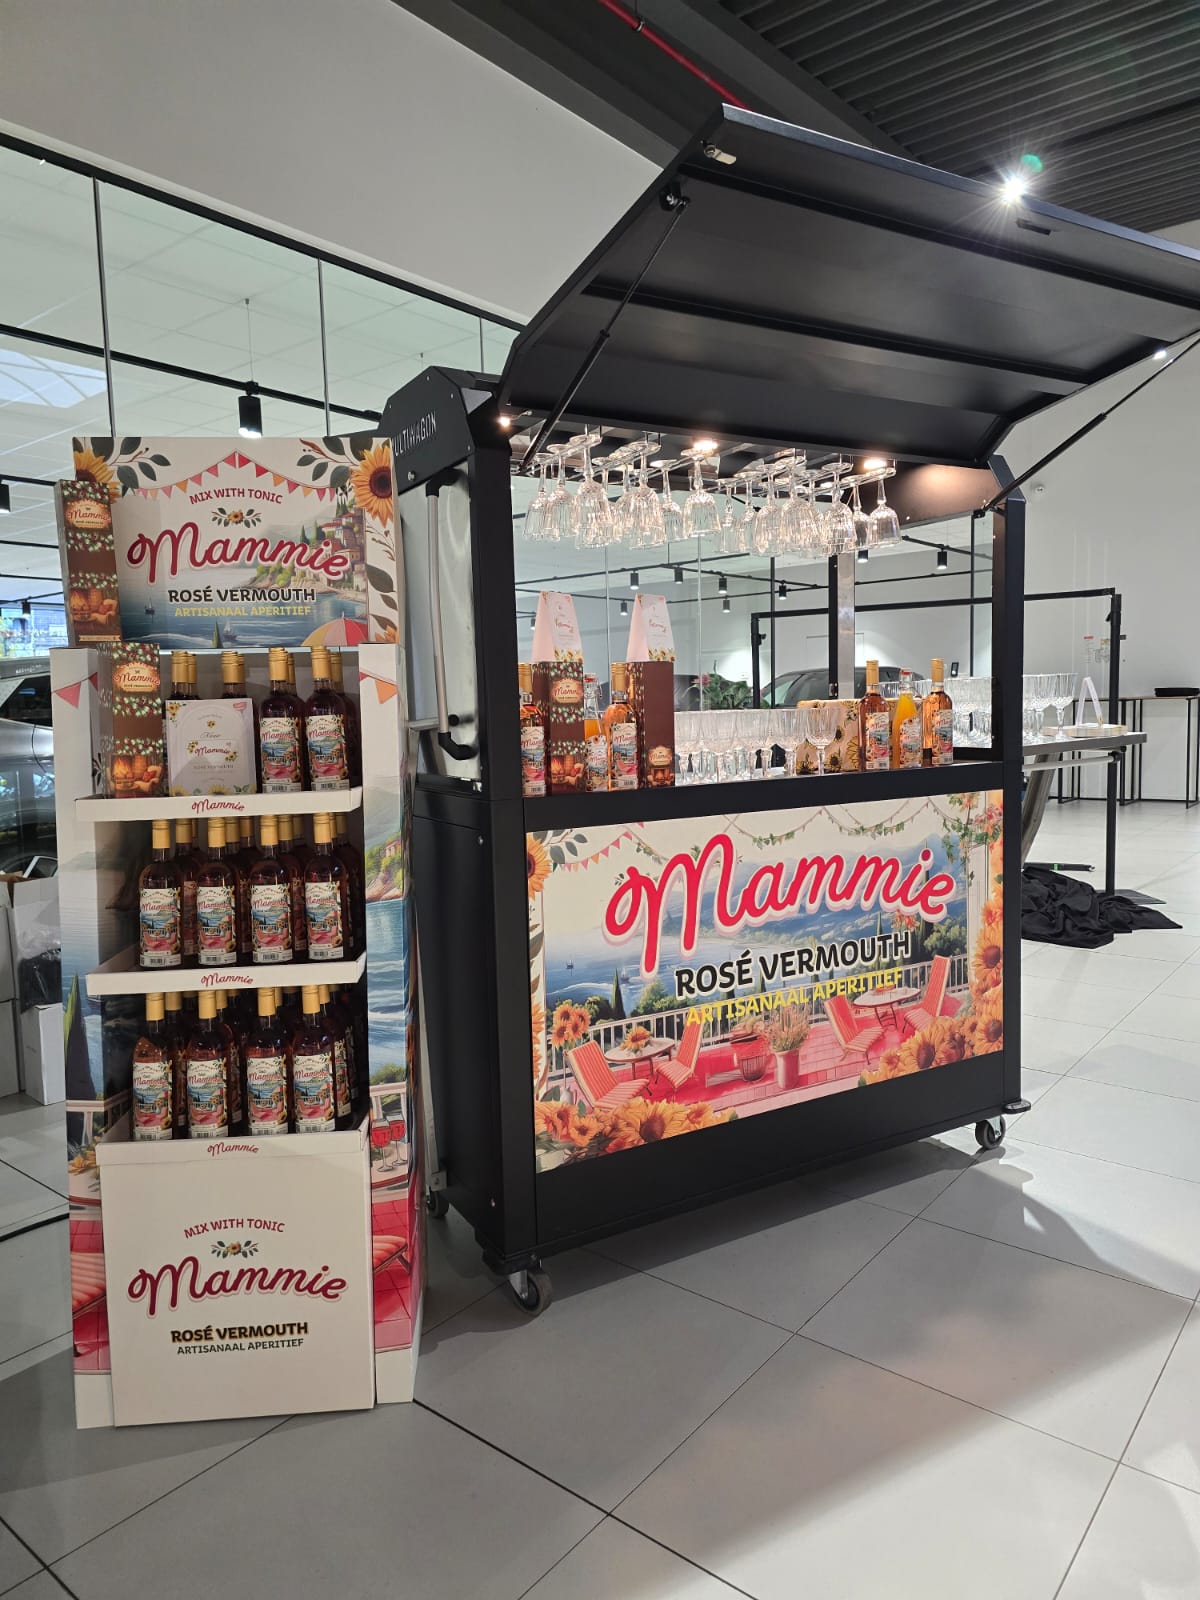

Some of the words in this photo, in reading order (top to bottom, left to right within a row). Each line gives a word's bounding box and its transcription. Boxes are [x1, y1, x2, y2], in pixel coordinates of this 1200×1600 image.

[391, 410, 437, 457] ULTIWAGON
[189, 490, 213, 505] MIX
[213, 487, 245, 499] WITH
[247, 489, 284, 504] TONIC
[127, 521, 350, 584] Mammie
[168, 585, 214, 603] ROSÉ
[216, 588, 316, 602] VERMOUTH
[175, 606, 249, 617] ARTISANAAL
[250, 605, 312, 616] APERITIEF
[191, 799, 245, 814] Mammie
[603, 832, 956, 976] Mammie
[676, 952, 753, 998] ROSÉ
[760, 931, 911, 980] VERMOUTH
[200, 972, 254, 987] Mammie
[685, 987, 811, 1027] ARTISANAAL
[813, 967, 904, 1001] APERITIEF
[207, 1141, 259, 1156] Mammie
[183, 1223, 209, 1239] MIX
[210, 1218, 244, 1231] WITH
[246, 1218, 286, 1233] TONIC
[127, 1255, 348, 1315] Mammie
[170, 1325, 213, 1344] ROSÉ
[216, 1321, 309, 1340] VERMOUTH
[177, 1342, 246, 1356] ARTISANAAL
[248, 1338, 304, 1351] APERITIEF
